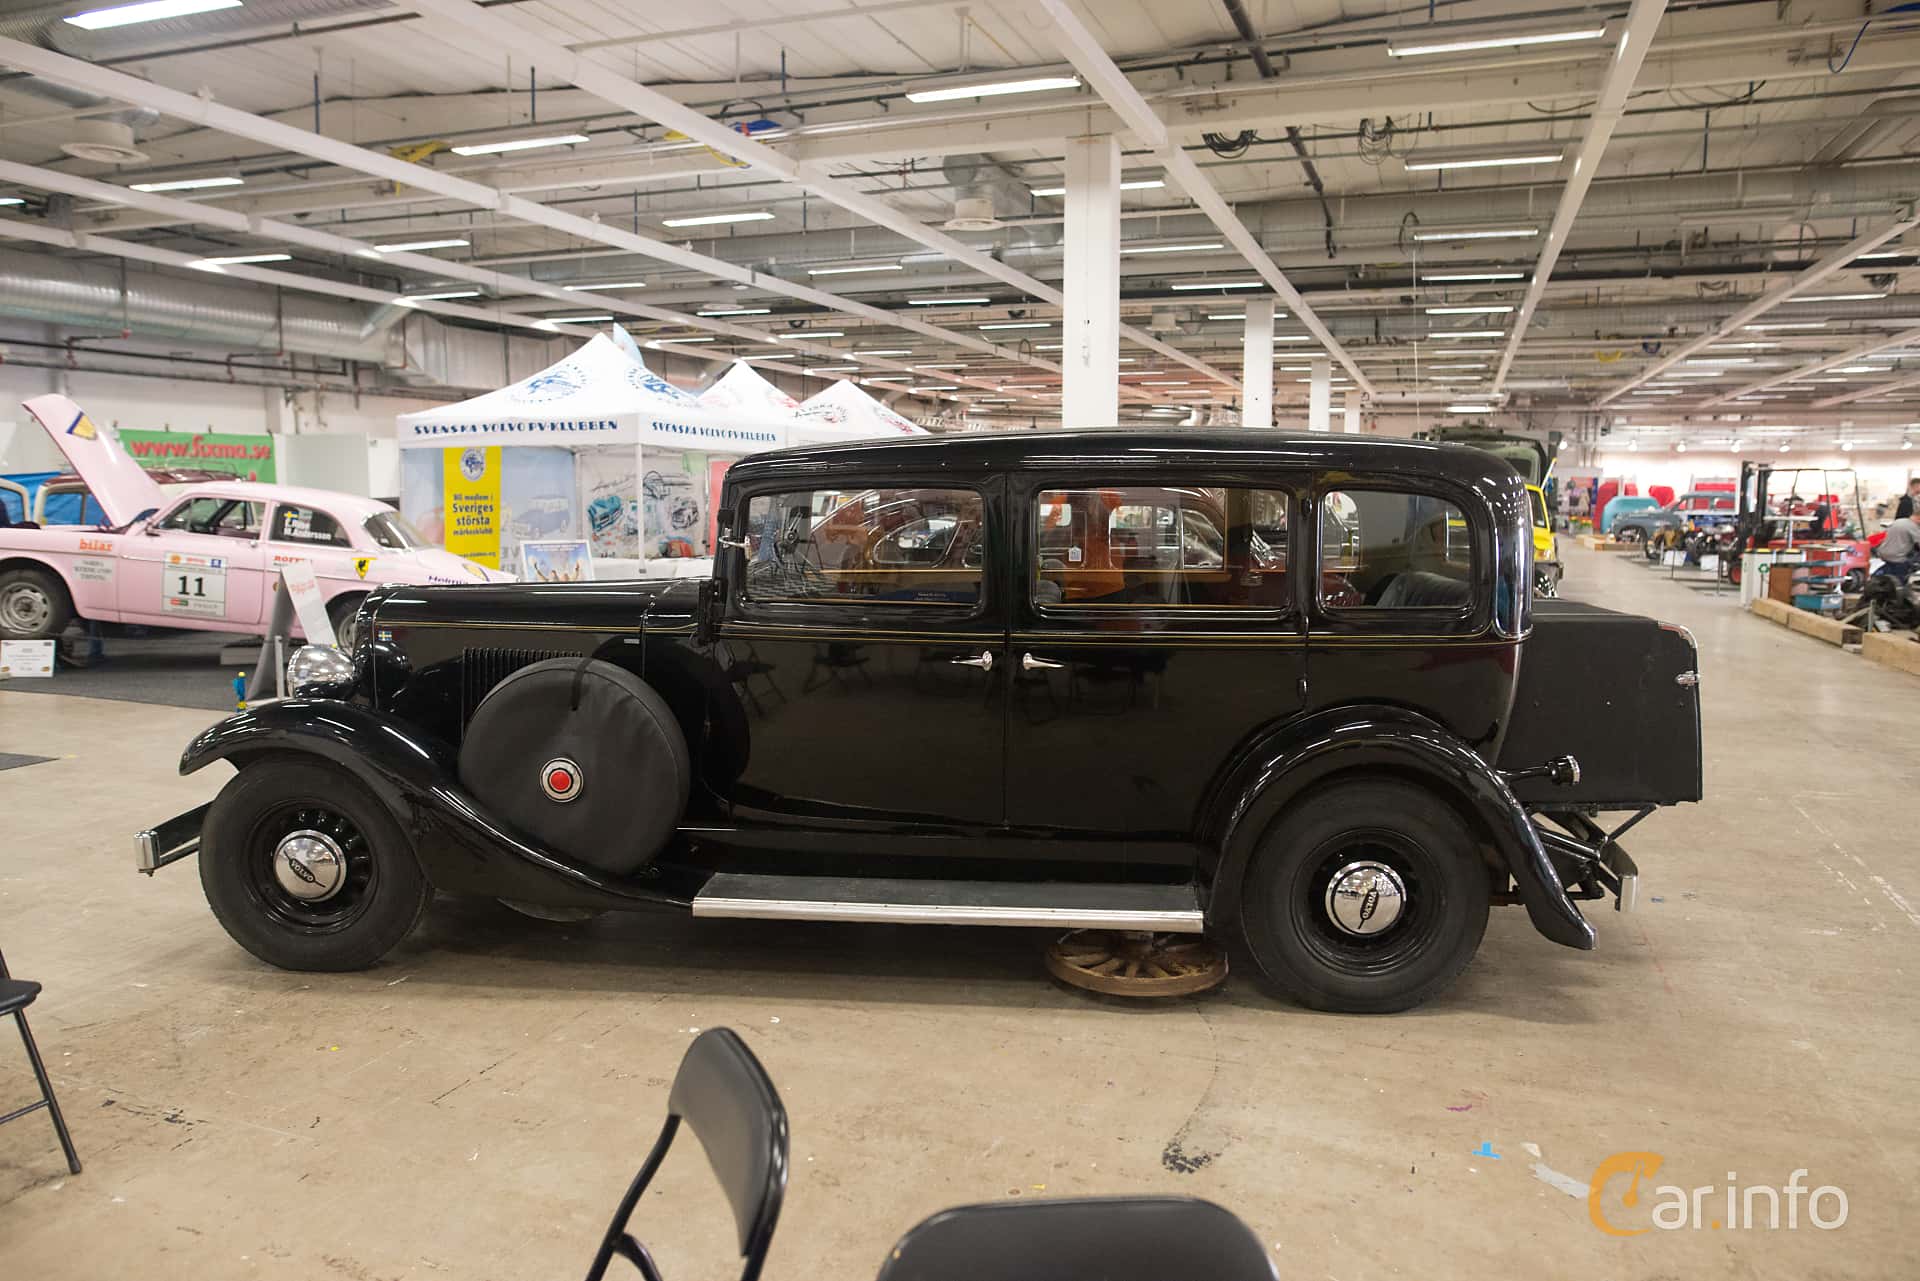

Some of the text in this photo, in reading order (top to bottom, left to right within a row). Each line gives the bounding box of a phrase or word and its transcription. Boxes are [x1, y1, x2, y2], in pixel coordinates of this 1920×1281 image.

[414, 425, 477, 434] SVENSKA
[483, 422, 525, 432] VOLVO
[652, 421, 697, 434] SVENSKA
[130, 434, 270, 459] www.fixma.se
[453, 503, 493, 515] Sveriges
[456, 515, 490, 526] största
[80, 539, 112, 551] bilar
[178, 576, 206, 597] 11
[1362, 890, 1377, 919] VOLVO
